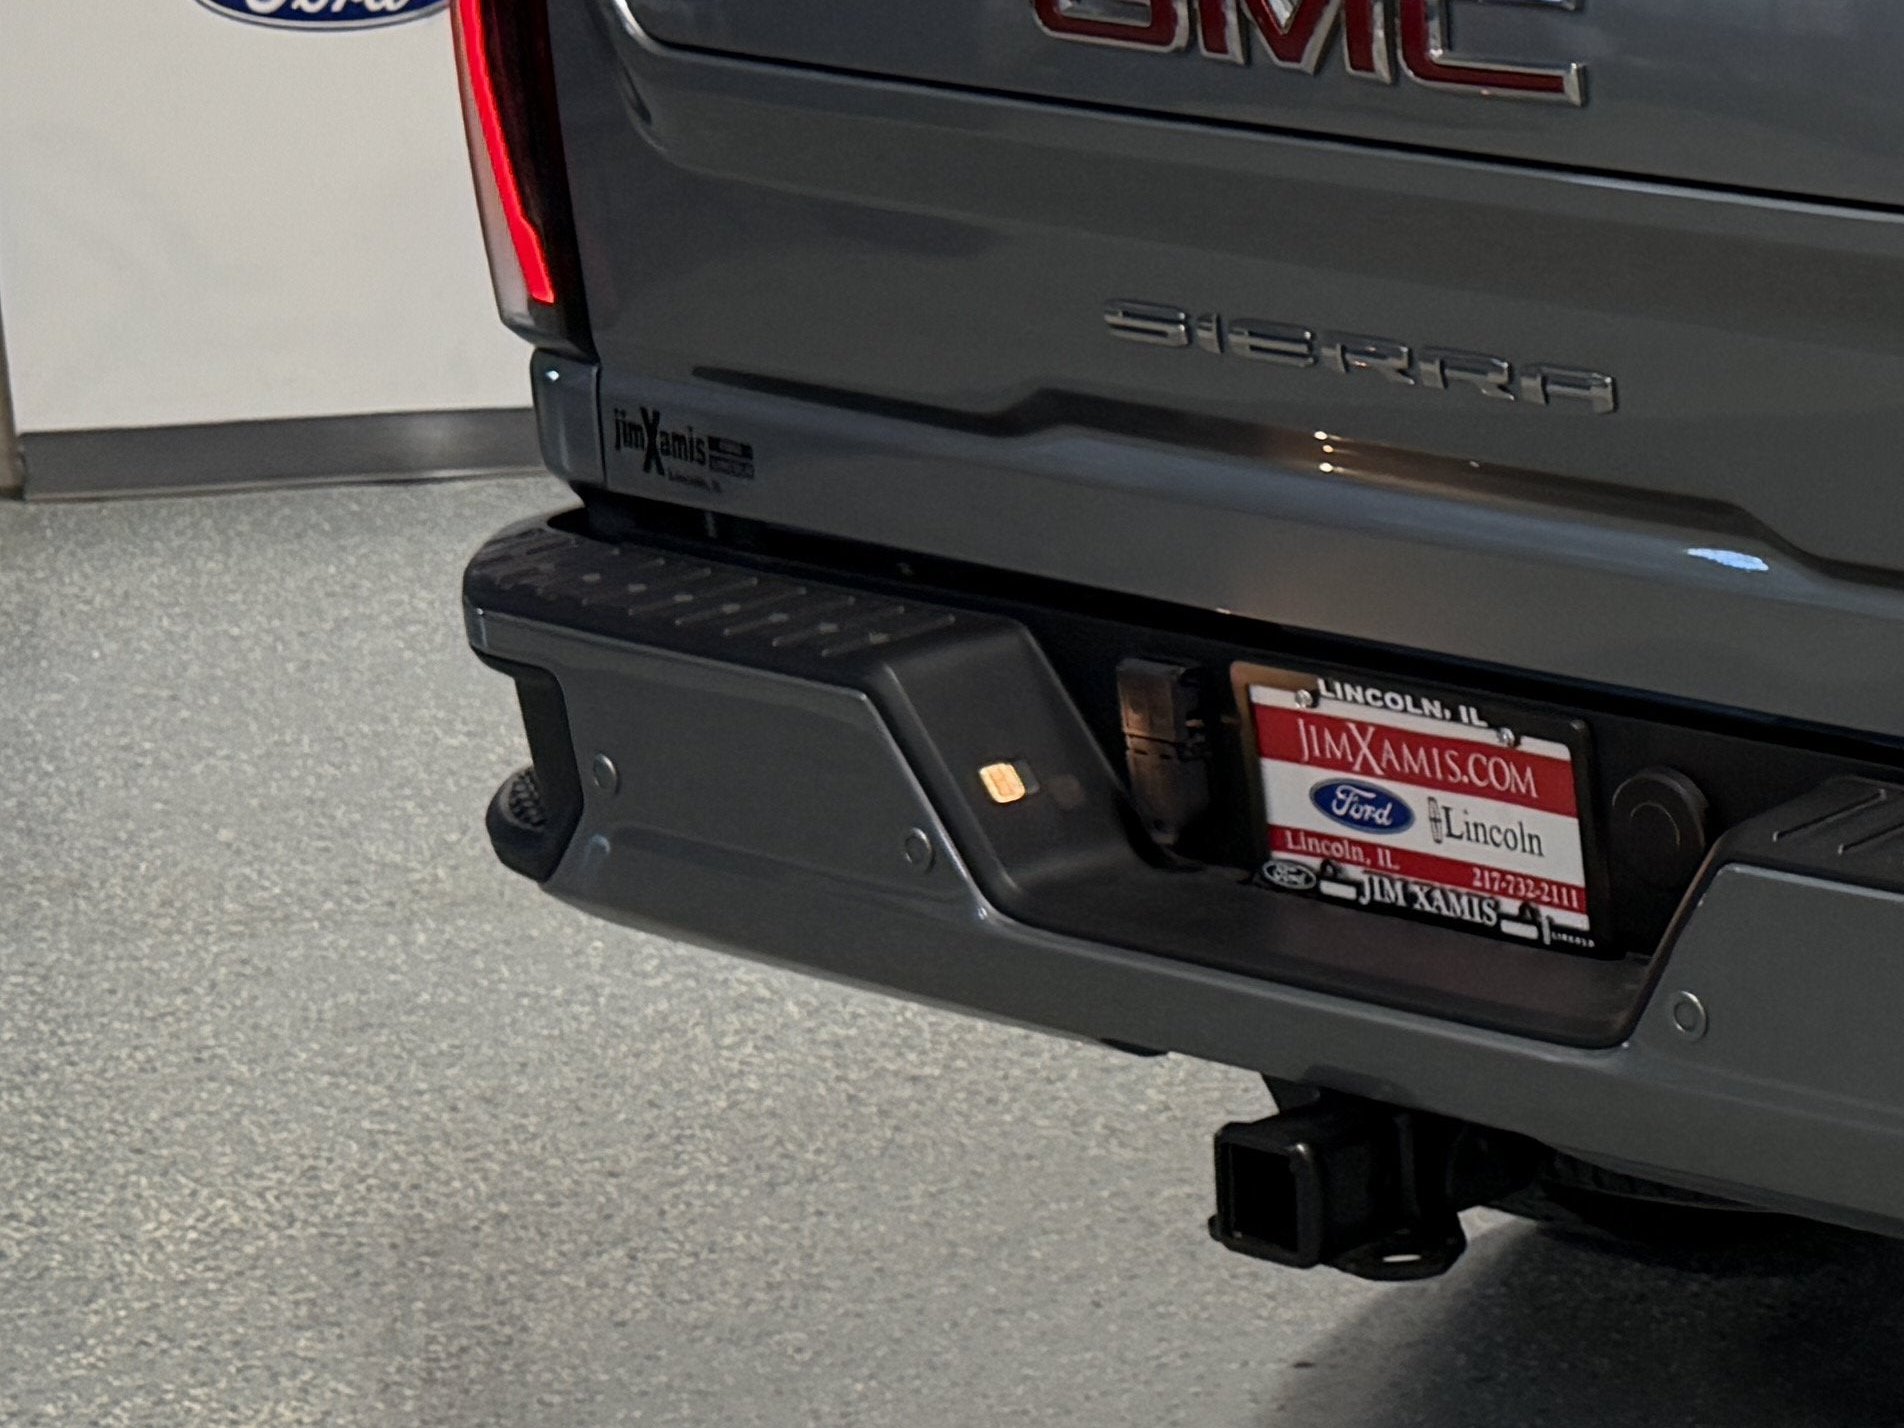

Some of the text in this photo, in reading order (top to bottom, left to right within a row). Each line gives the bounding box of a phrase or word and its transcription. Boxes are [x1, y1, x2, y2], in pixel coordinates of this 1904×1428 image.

[1103, 297, 1619, 415] SIERRA
[1317, 678, 1488, 727] LINCOLN, IL
[1331, 784, 1393, 826] Ford
[1284, 829, 1400, 871] Lincoln, IL
[1441, 805, 1545, 857] Lincoln
[1358, 872, 1498, 928] JIM XAMIS
